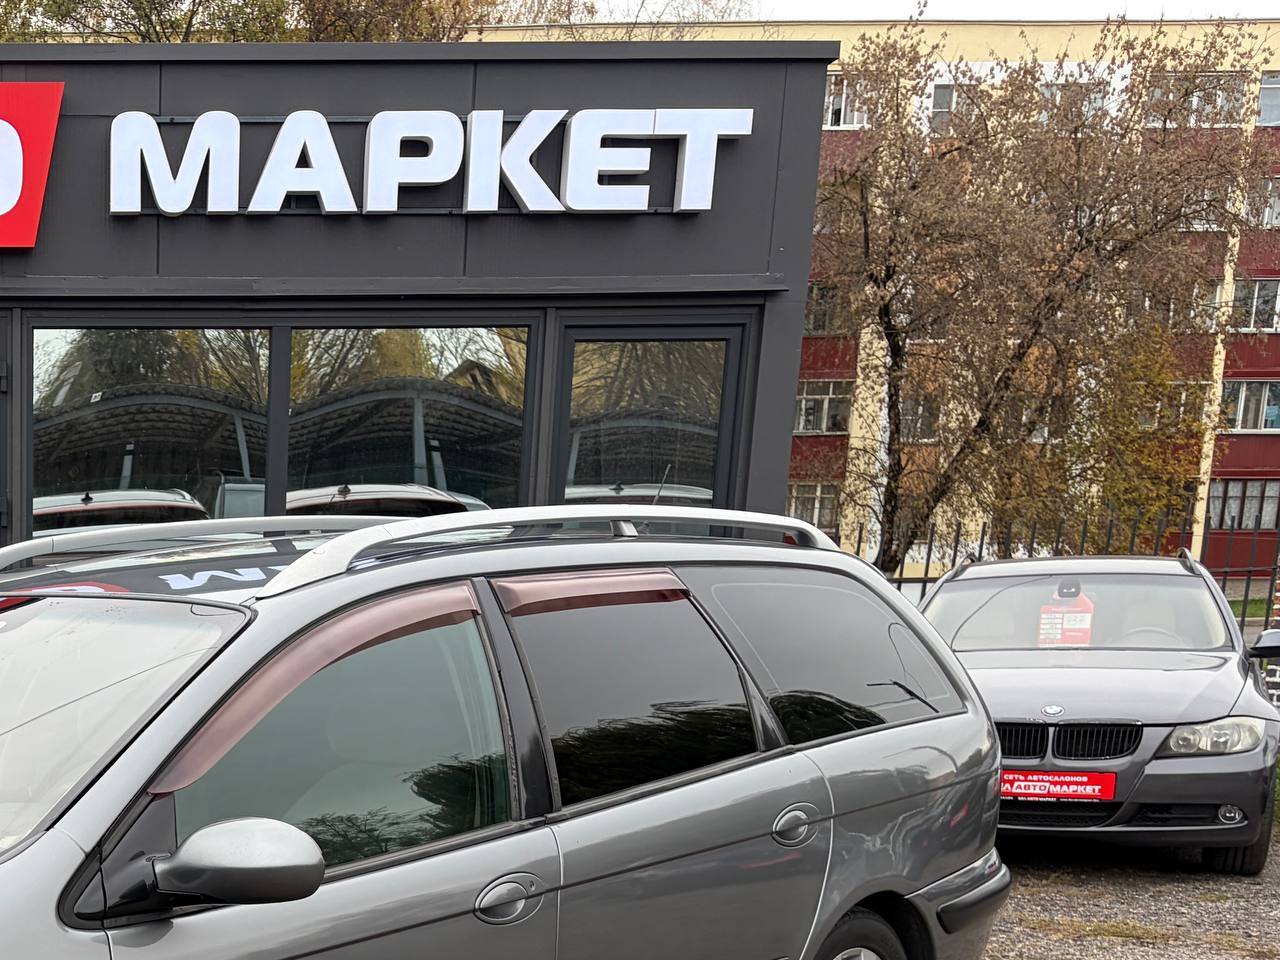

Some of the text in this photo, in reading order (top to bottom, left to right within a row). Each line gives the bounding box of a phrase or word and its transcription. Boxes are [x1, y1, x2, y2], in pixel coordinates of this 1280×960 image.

[109, 108, 754, 217] МАРКЕТ
[1014, 783, 1048, 792] АВТО
[1049, 784, 1102, 793] МАРКЕТ
